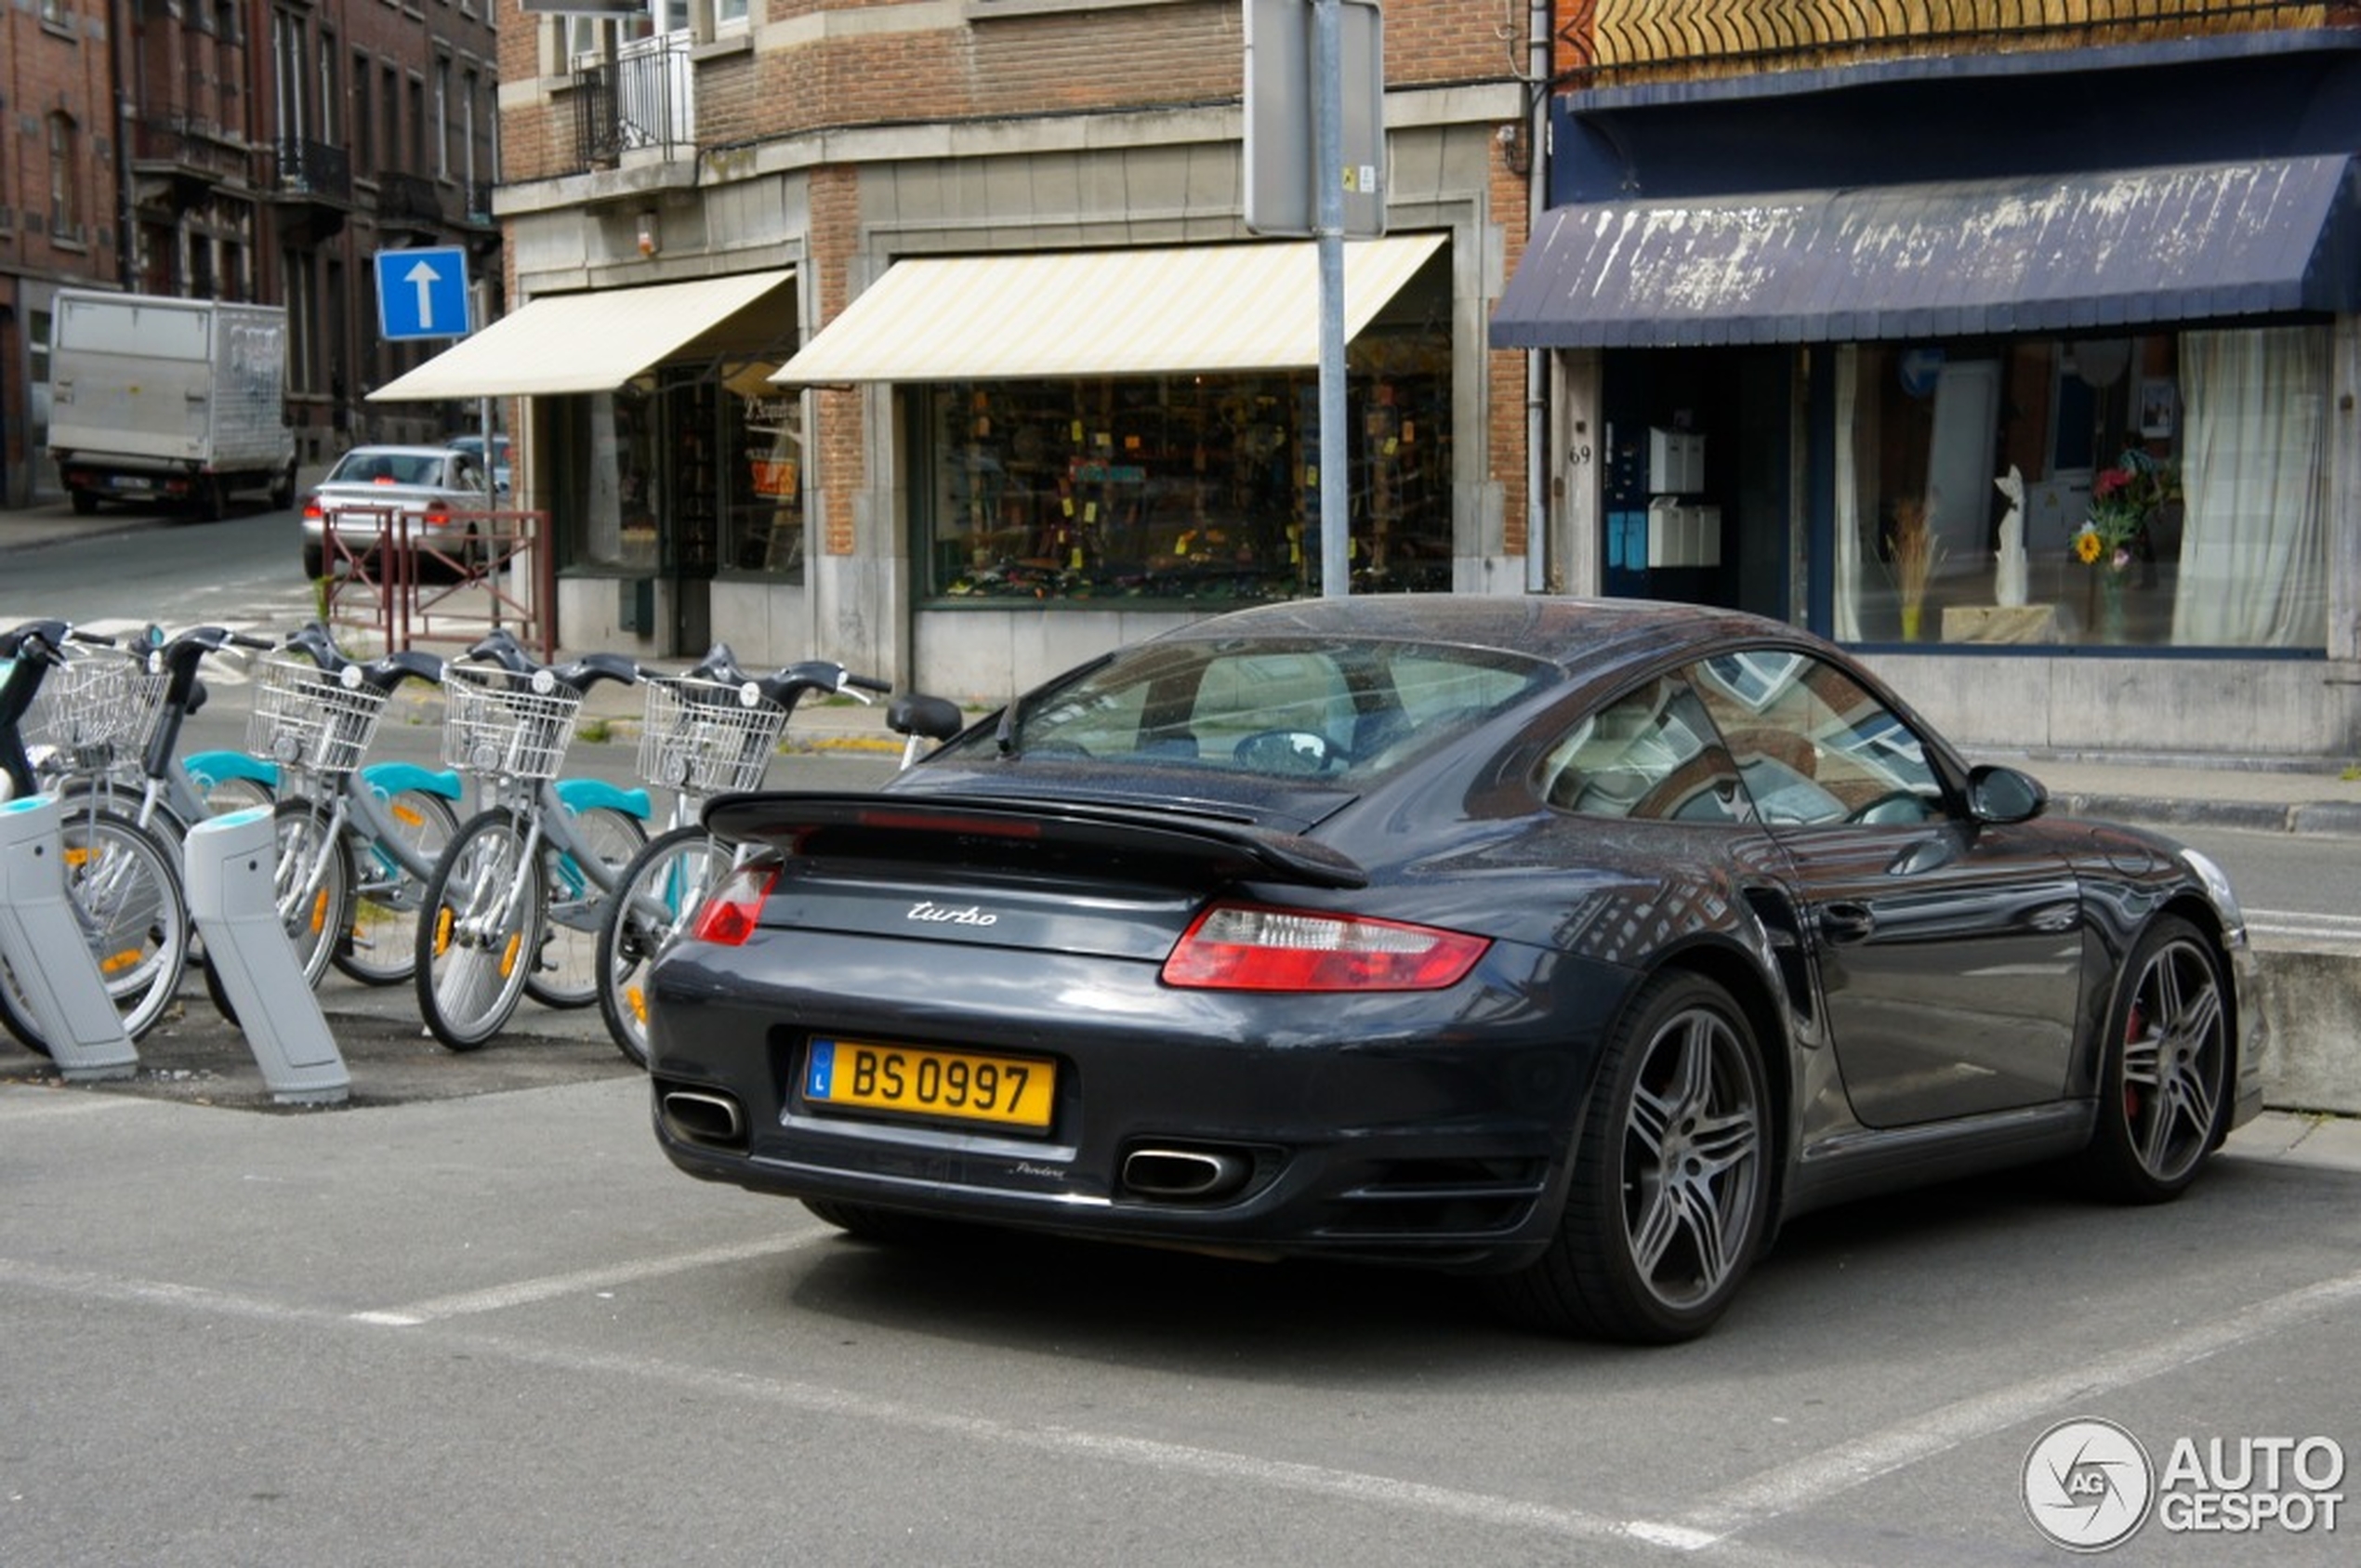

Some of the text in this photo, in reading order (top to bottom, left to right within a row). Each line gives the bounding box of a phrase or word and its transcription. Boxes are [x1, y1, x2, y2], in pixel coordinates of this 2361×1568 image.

[1569, 444, 1591, 465] 69
[907, 901, 997, 926] turbo
[815, 1074, 824, 1091] L
